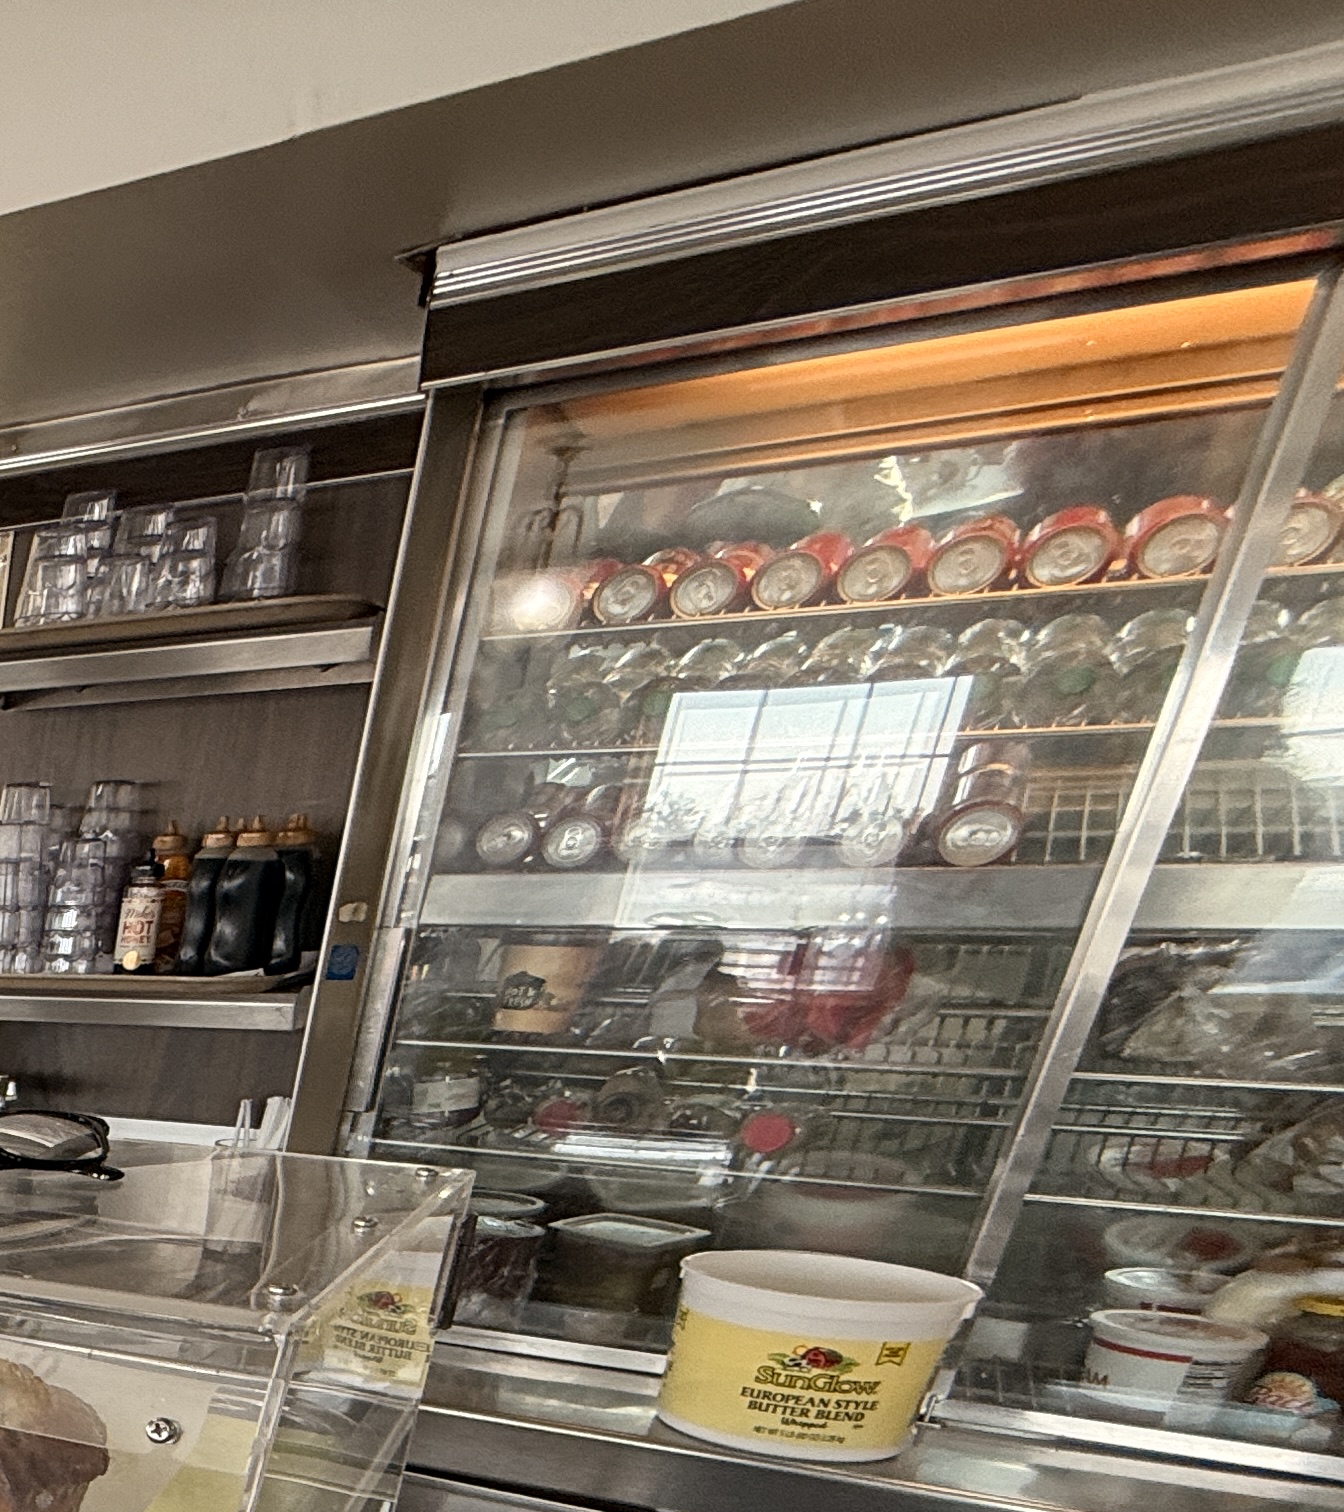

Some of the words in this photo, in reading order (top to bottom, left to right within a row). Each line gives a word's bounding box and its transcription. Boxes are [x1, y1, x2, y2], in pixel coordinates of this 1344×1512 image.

[122, 920, 154, 935] HOT
[755, 1366, 881, 1396] SunGlow
[740, 1386, 831, 1409] EUROPEAN
[832, 1400, 879, 1411] STYLE
[747, 1400, 810, 1418] BUTTER
[814, 1409, 865, 1422] BLEND
